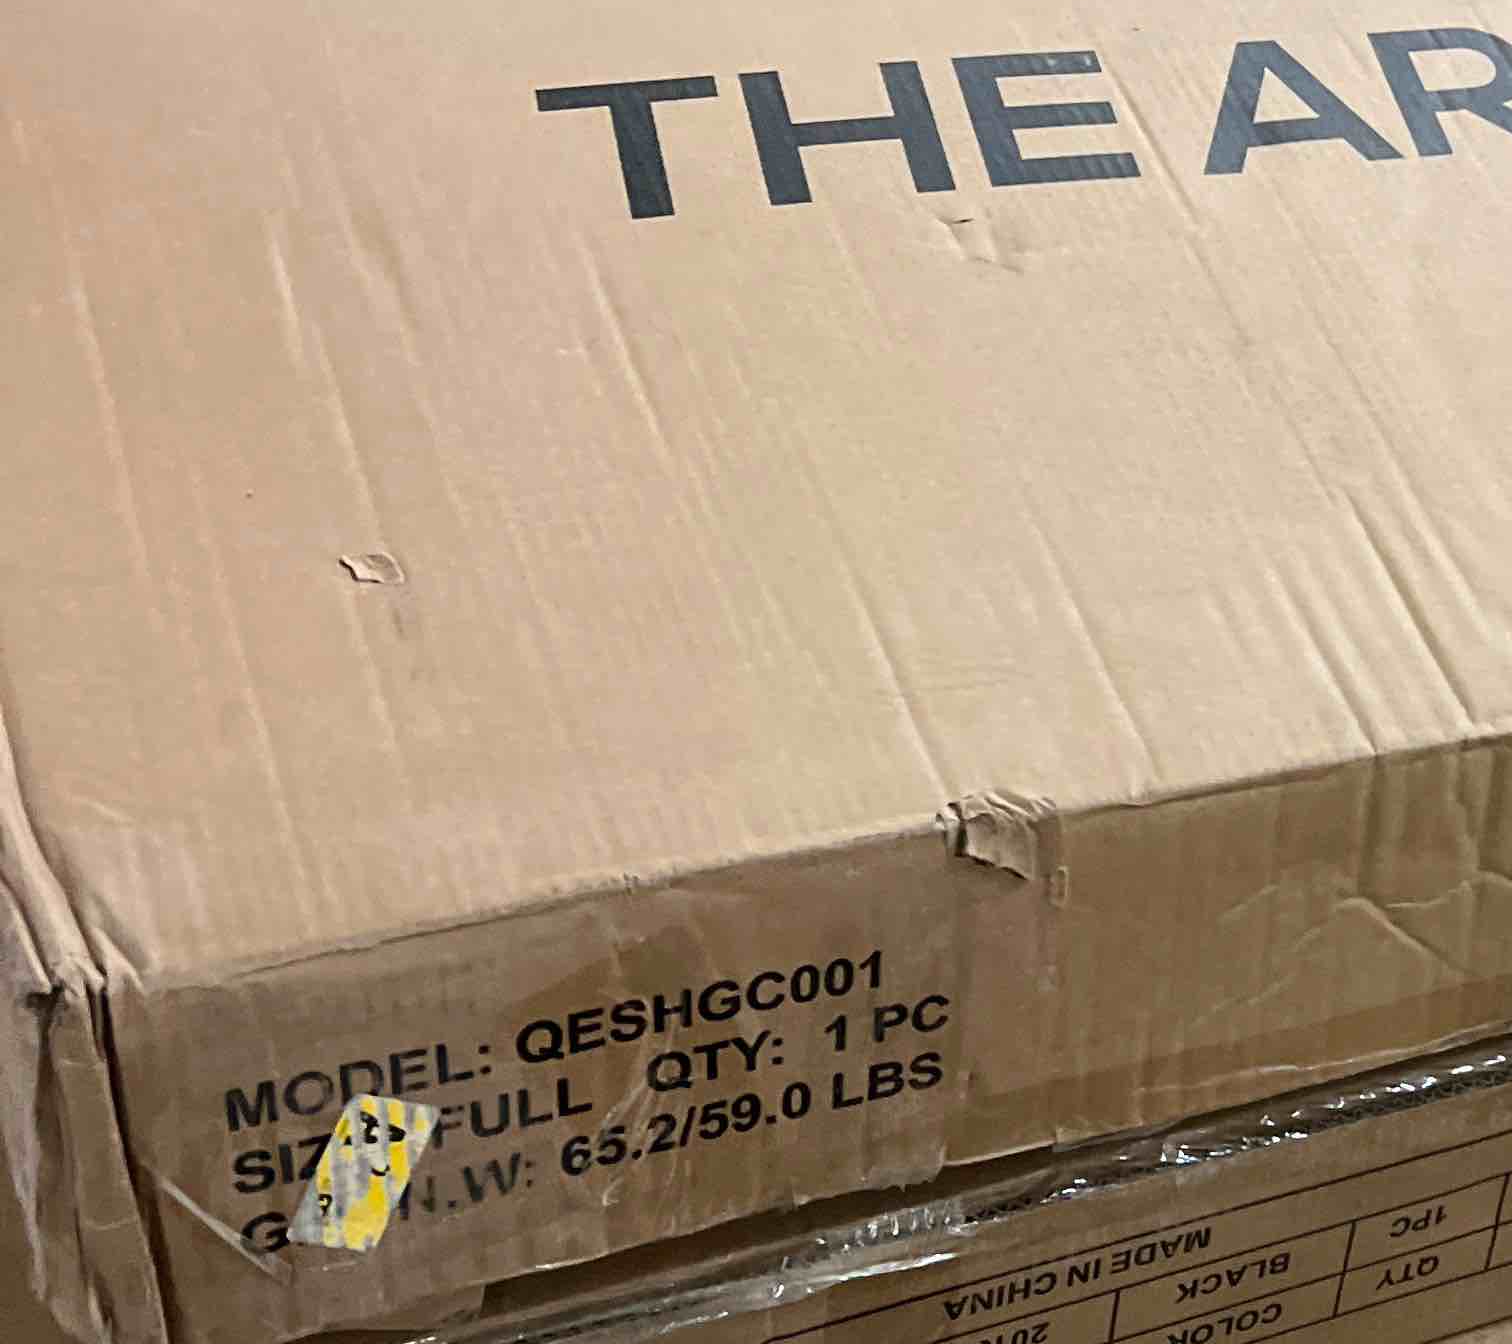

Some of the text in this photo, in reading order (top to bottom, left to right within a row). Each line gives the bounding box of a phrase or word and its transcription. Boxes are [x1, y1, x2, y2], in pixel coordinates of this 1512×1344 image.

[535, 51, 1142, 219] THE
[224, 949, 886, 1134] MODEL: QESHGC001
[433, 1080, 593, 1150] FULL
[646, 1032, 786, 1094] QTY:
[824, 1014, 848, 1053] 1
[873, 993, 952, 1043] PC
[560, 1081, 812, 1176] 65.2/59.0
[831, 1051, 945, 1111] LBS
[943, 1225, 1214, 1321] MADE IN CHINA
[1377, 1254, 1441, 1291] QTY
[1388, 1205, 1448, 1240] 1PC
[1177, 1251, 1292, 1305] BLACK
